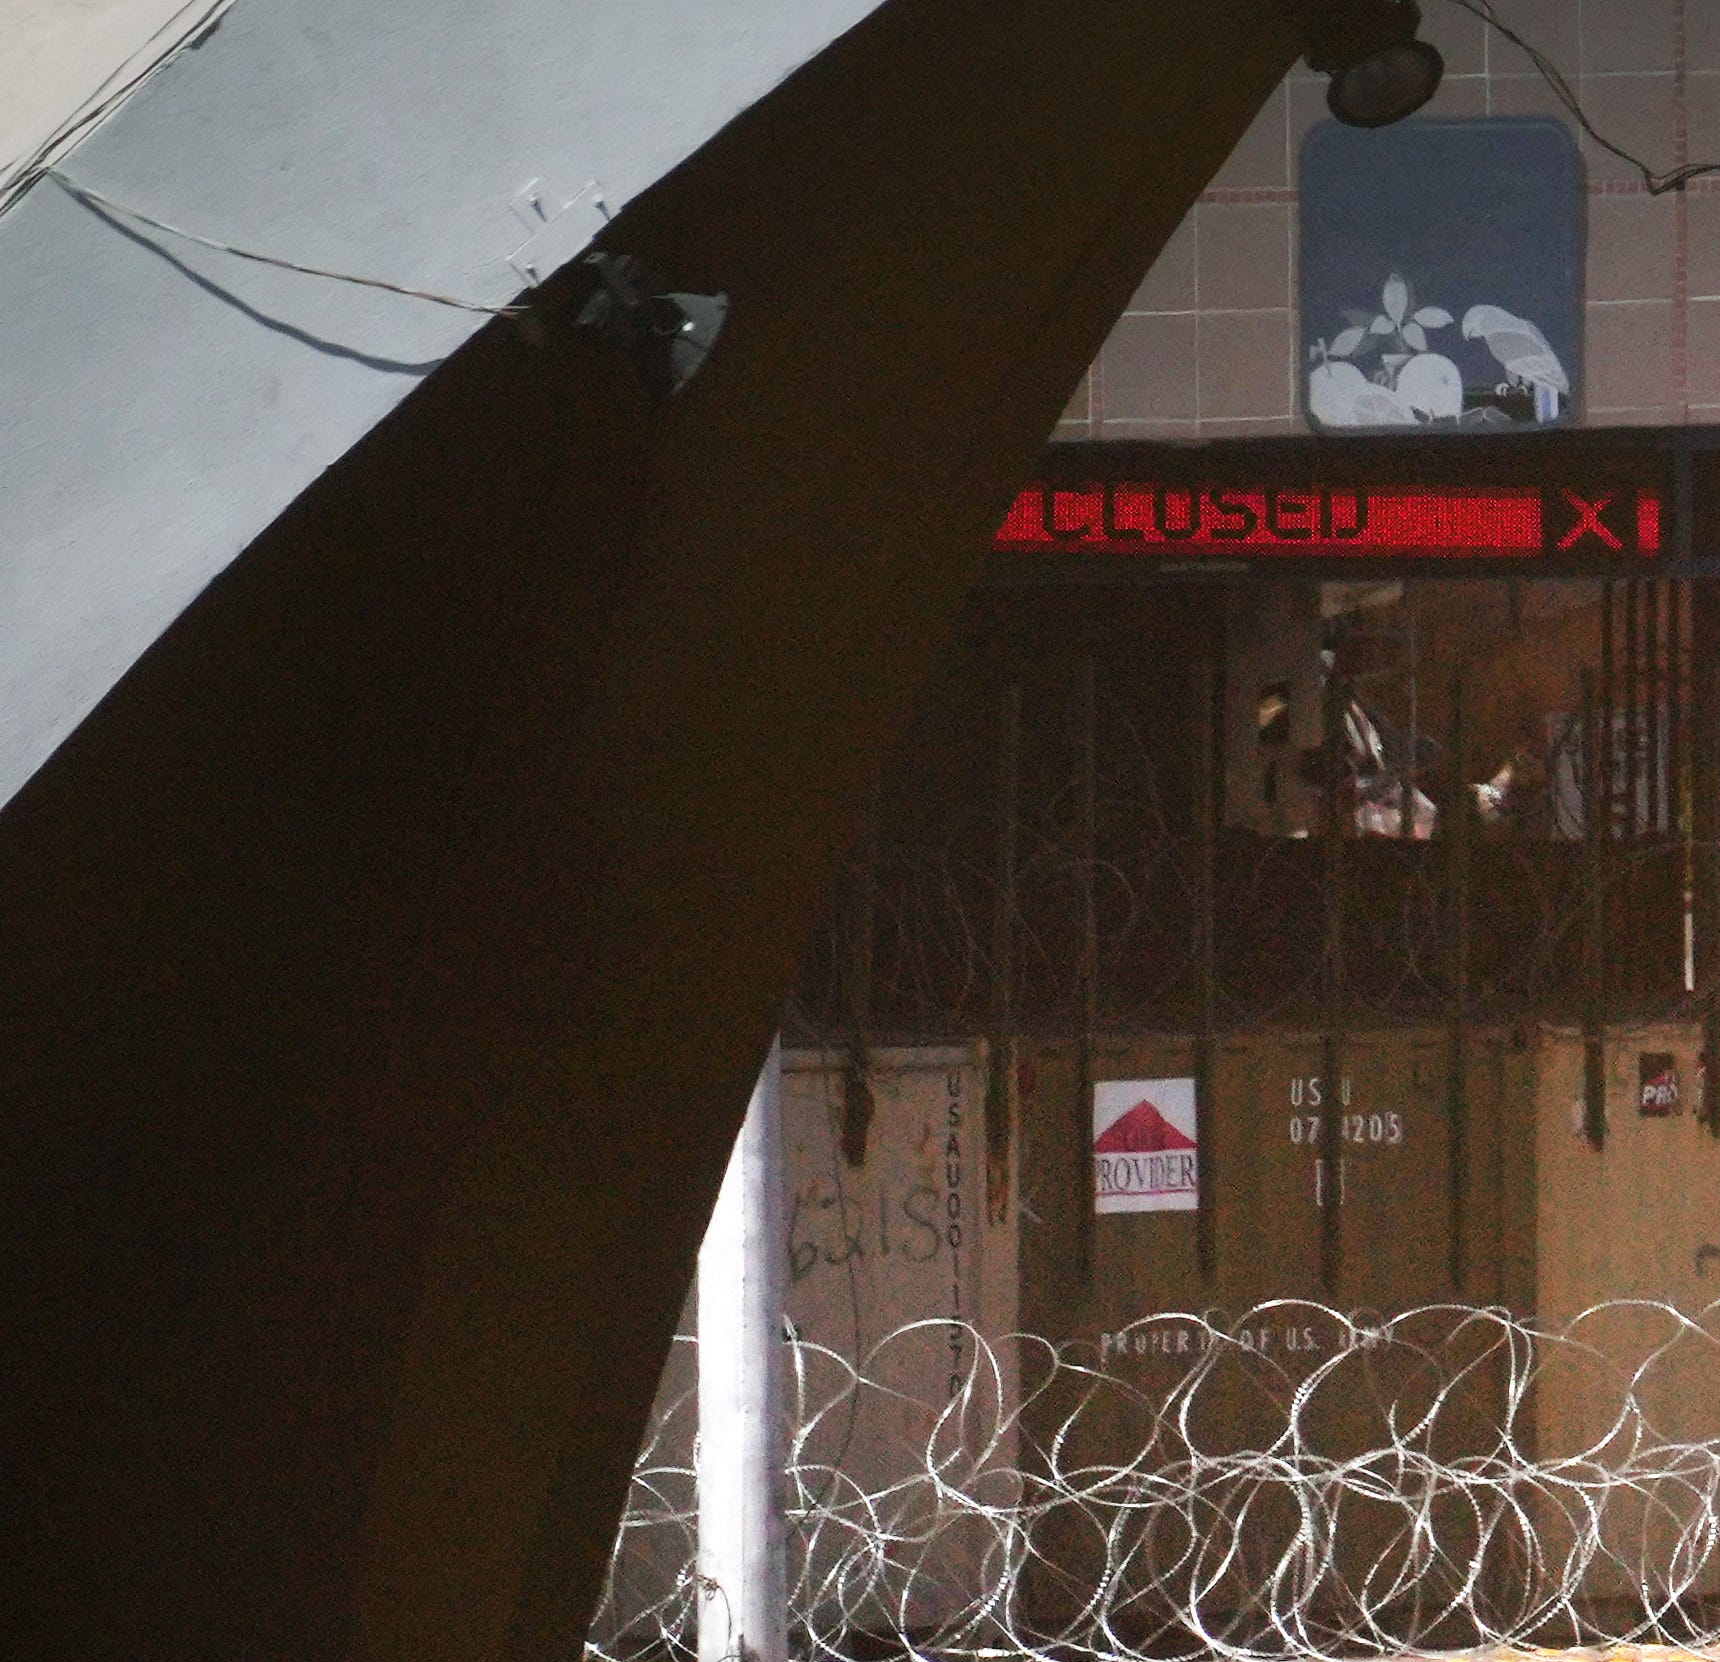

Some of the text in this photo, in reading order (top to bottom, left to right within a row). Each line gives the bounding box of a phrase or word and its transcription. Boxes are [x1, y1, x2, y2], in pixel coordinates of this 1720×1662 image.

[1042, 483, 1369, 541] CLOSED
[1101, 1329, 1222, 1355] PROPERT
[1240, 1328, 1268, 1351] OF
[1286, 1327, 1320, 1352] U.S.
